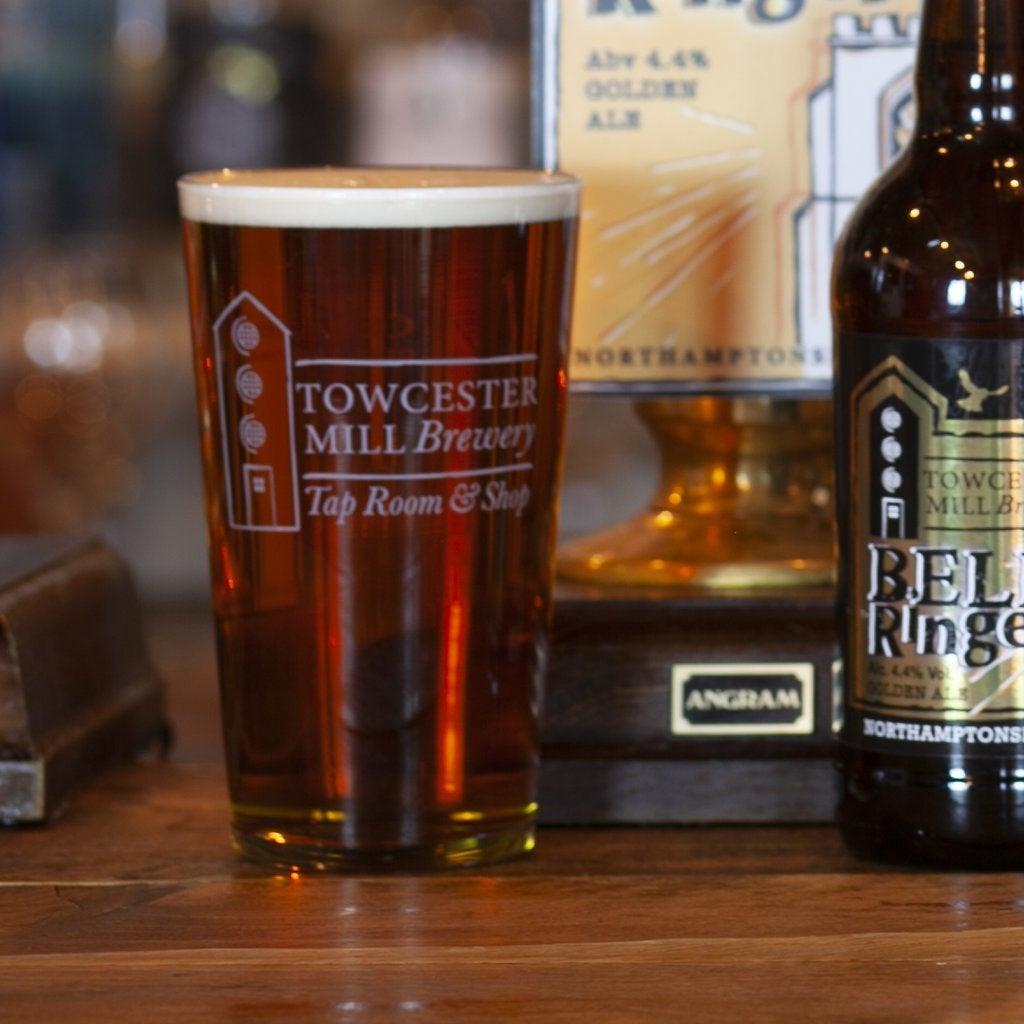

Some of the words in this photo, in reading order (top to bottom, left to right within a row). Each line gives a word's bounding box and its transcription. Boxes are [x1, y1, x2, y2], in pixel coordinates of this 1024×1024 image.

[585, 49, 637, 70] Abv
[645, 49, 711, 71] 4.4%
[585, 79, 698, 100] GOLDEN
[586, 109, 641, 130] ALE
[576, 345, 826, 367] NORTHAMPTONS
[295, 377, 538, 414] TOWCESTER
[304, 424, 406, 456] MILL
[411, 419, 536, 458] Brewery
[304, 485, 356, 526] Tap
[362, 485, 443, 517] Room
[449, 482, 481, 513] &
[480, 480, 531, 517] Shop
[926, 494, 991, 515] MILL
[685, 687, 801, 711] ANGRAM
